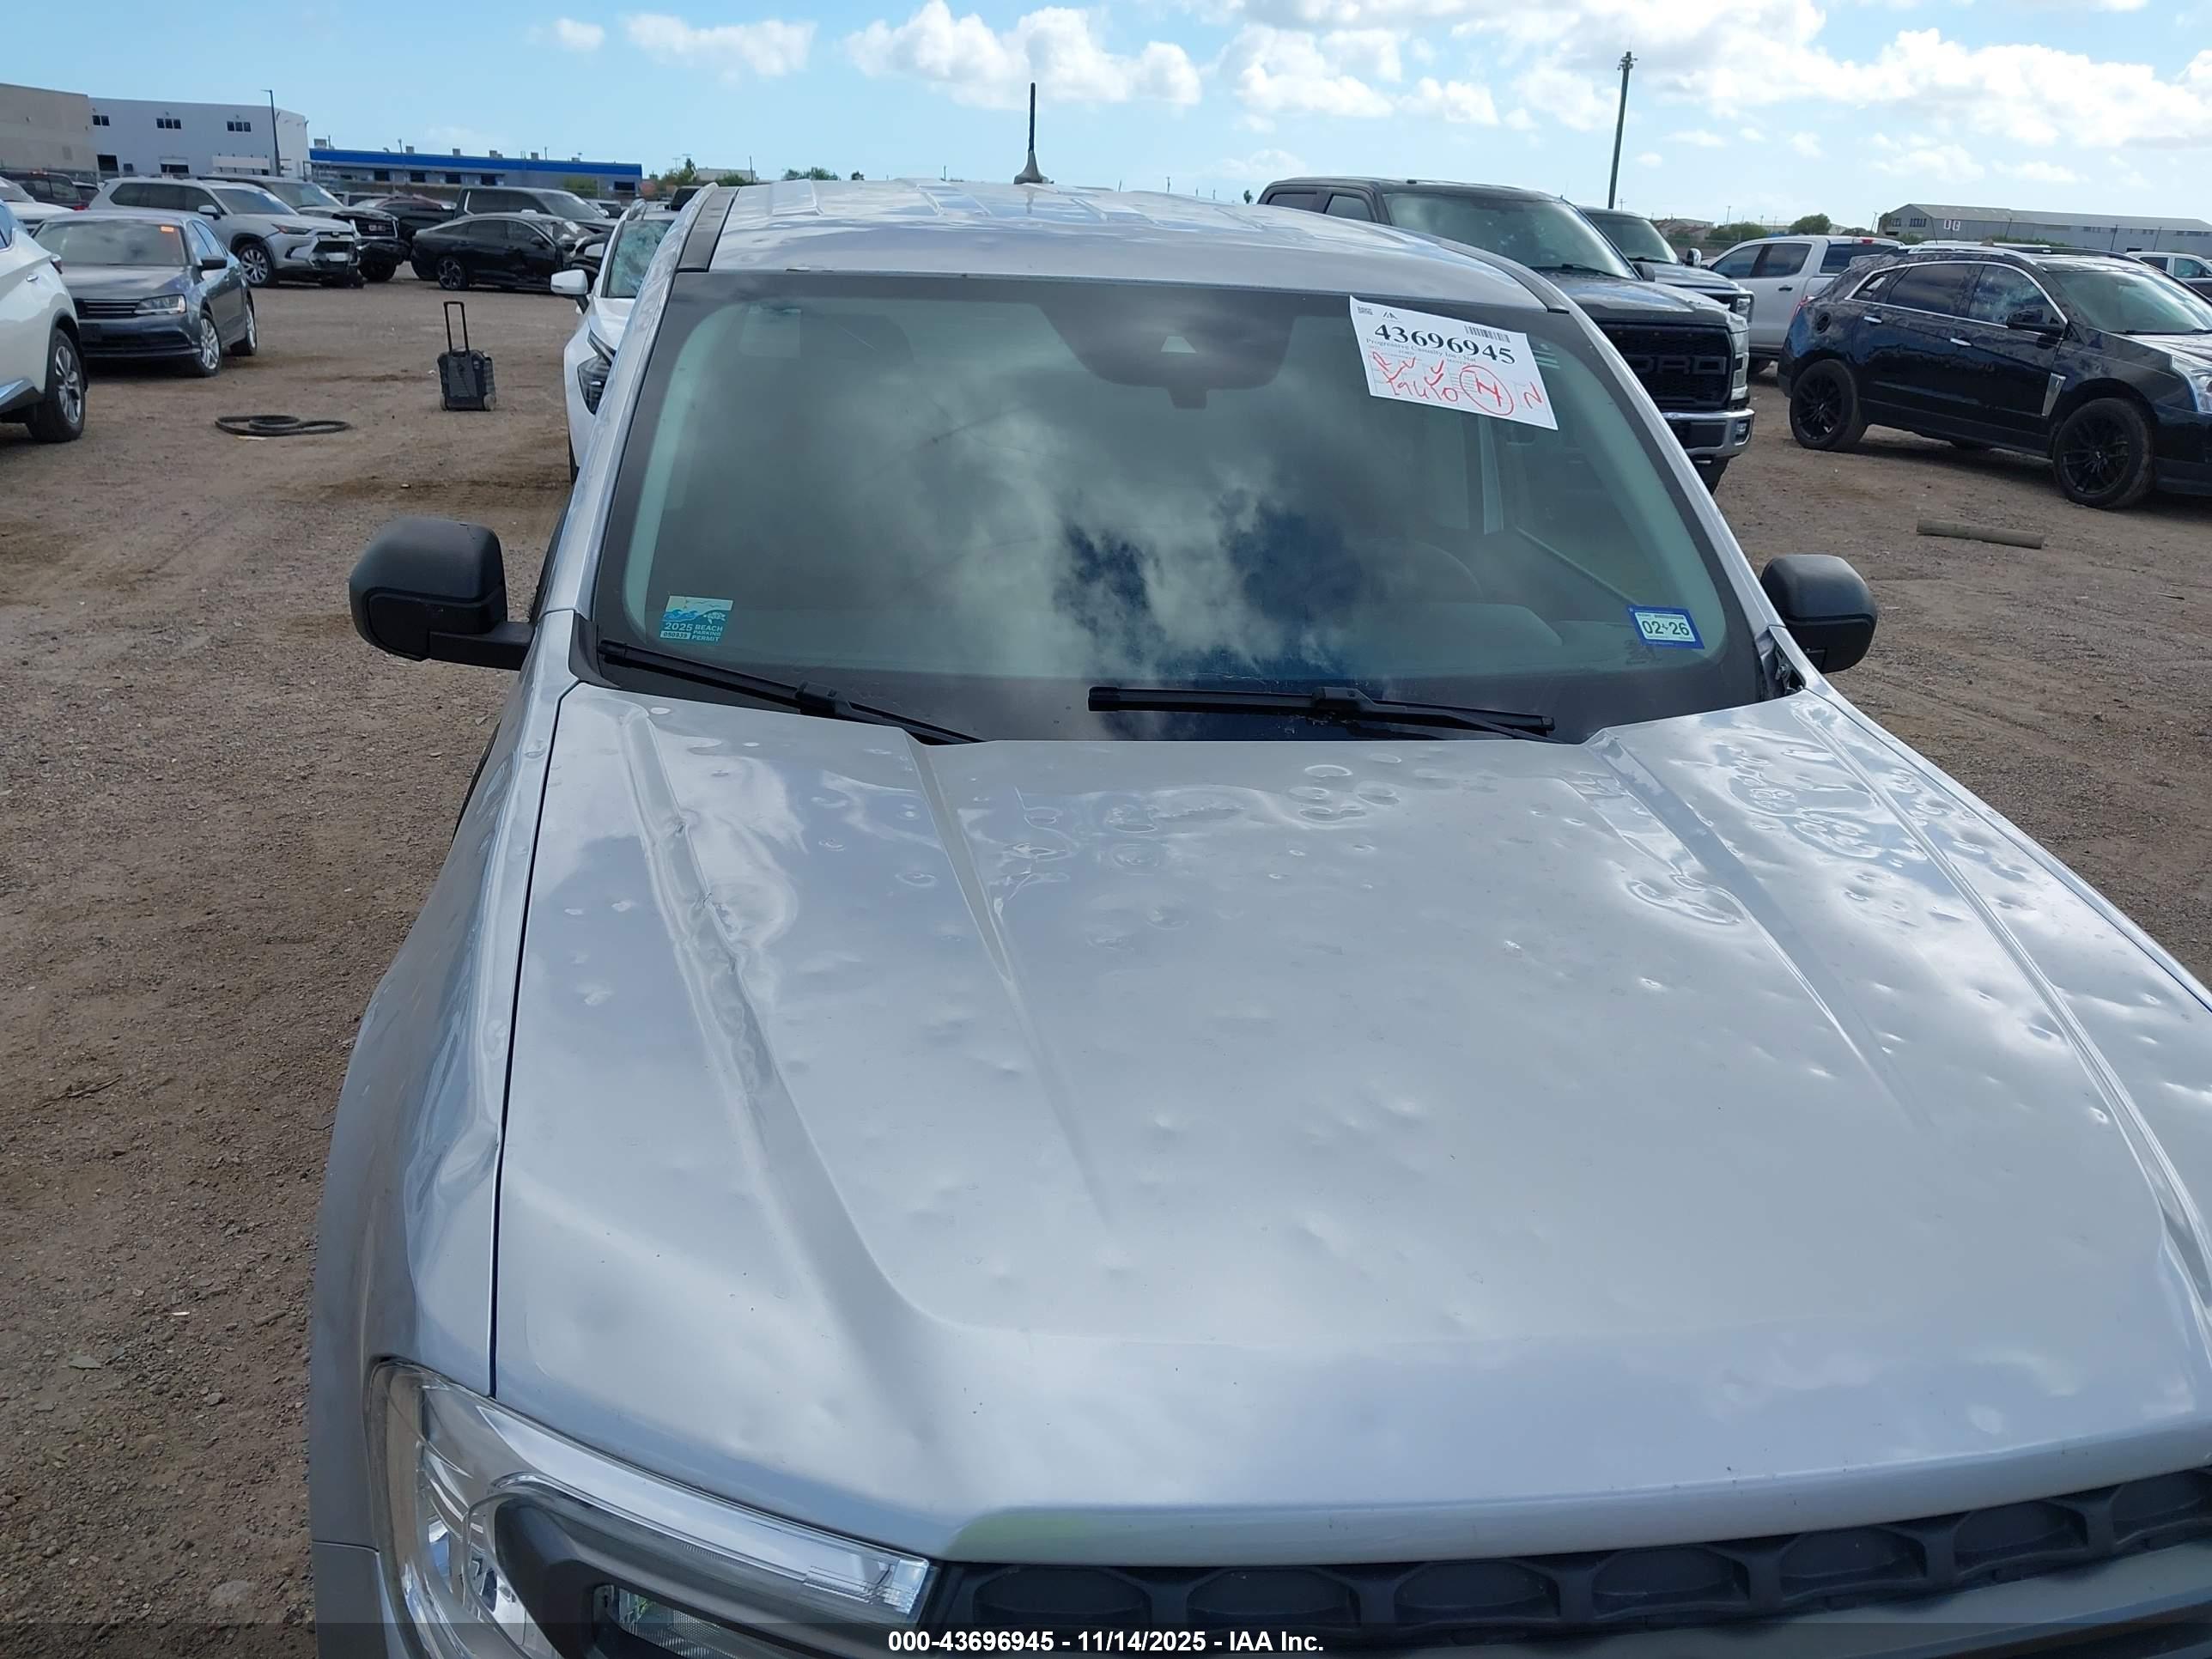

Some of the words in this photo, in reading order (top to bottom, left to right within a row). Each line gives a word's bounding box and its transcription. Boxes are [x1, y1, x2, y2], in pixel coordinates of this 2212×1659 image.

[1366, 337, 1410, 351] Progressive
[1410, 345, 1443, 357] Casualty
[1374, 324, 1516, 365] 43696945
[1625, 354, 1727, 375] ORD
[664, 623, 693, 631] 2025
